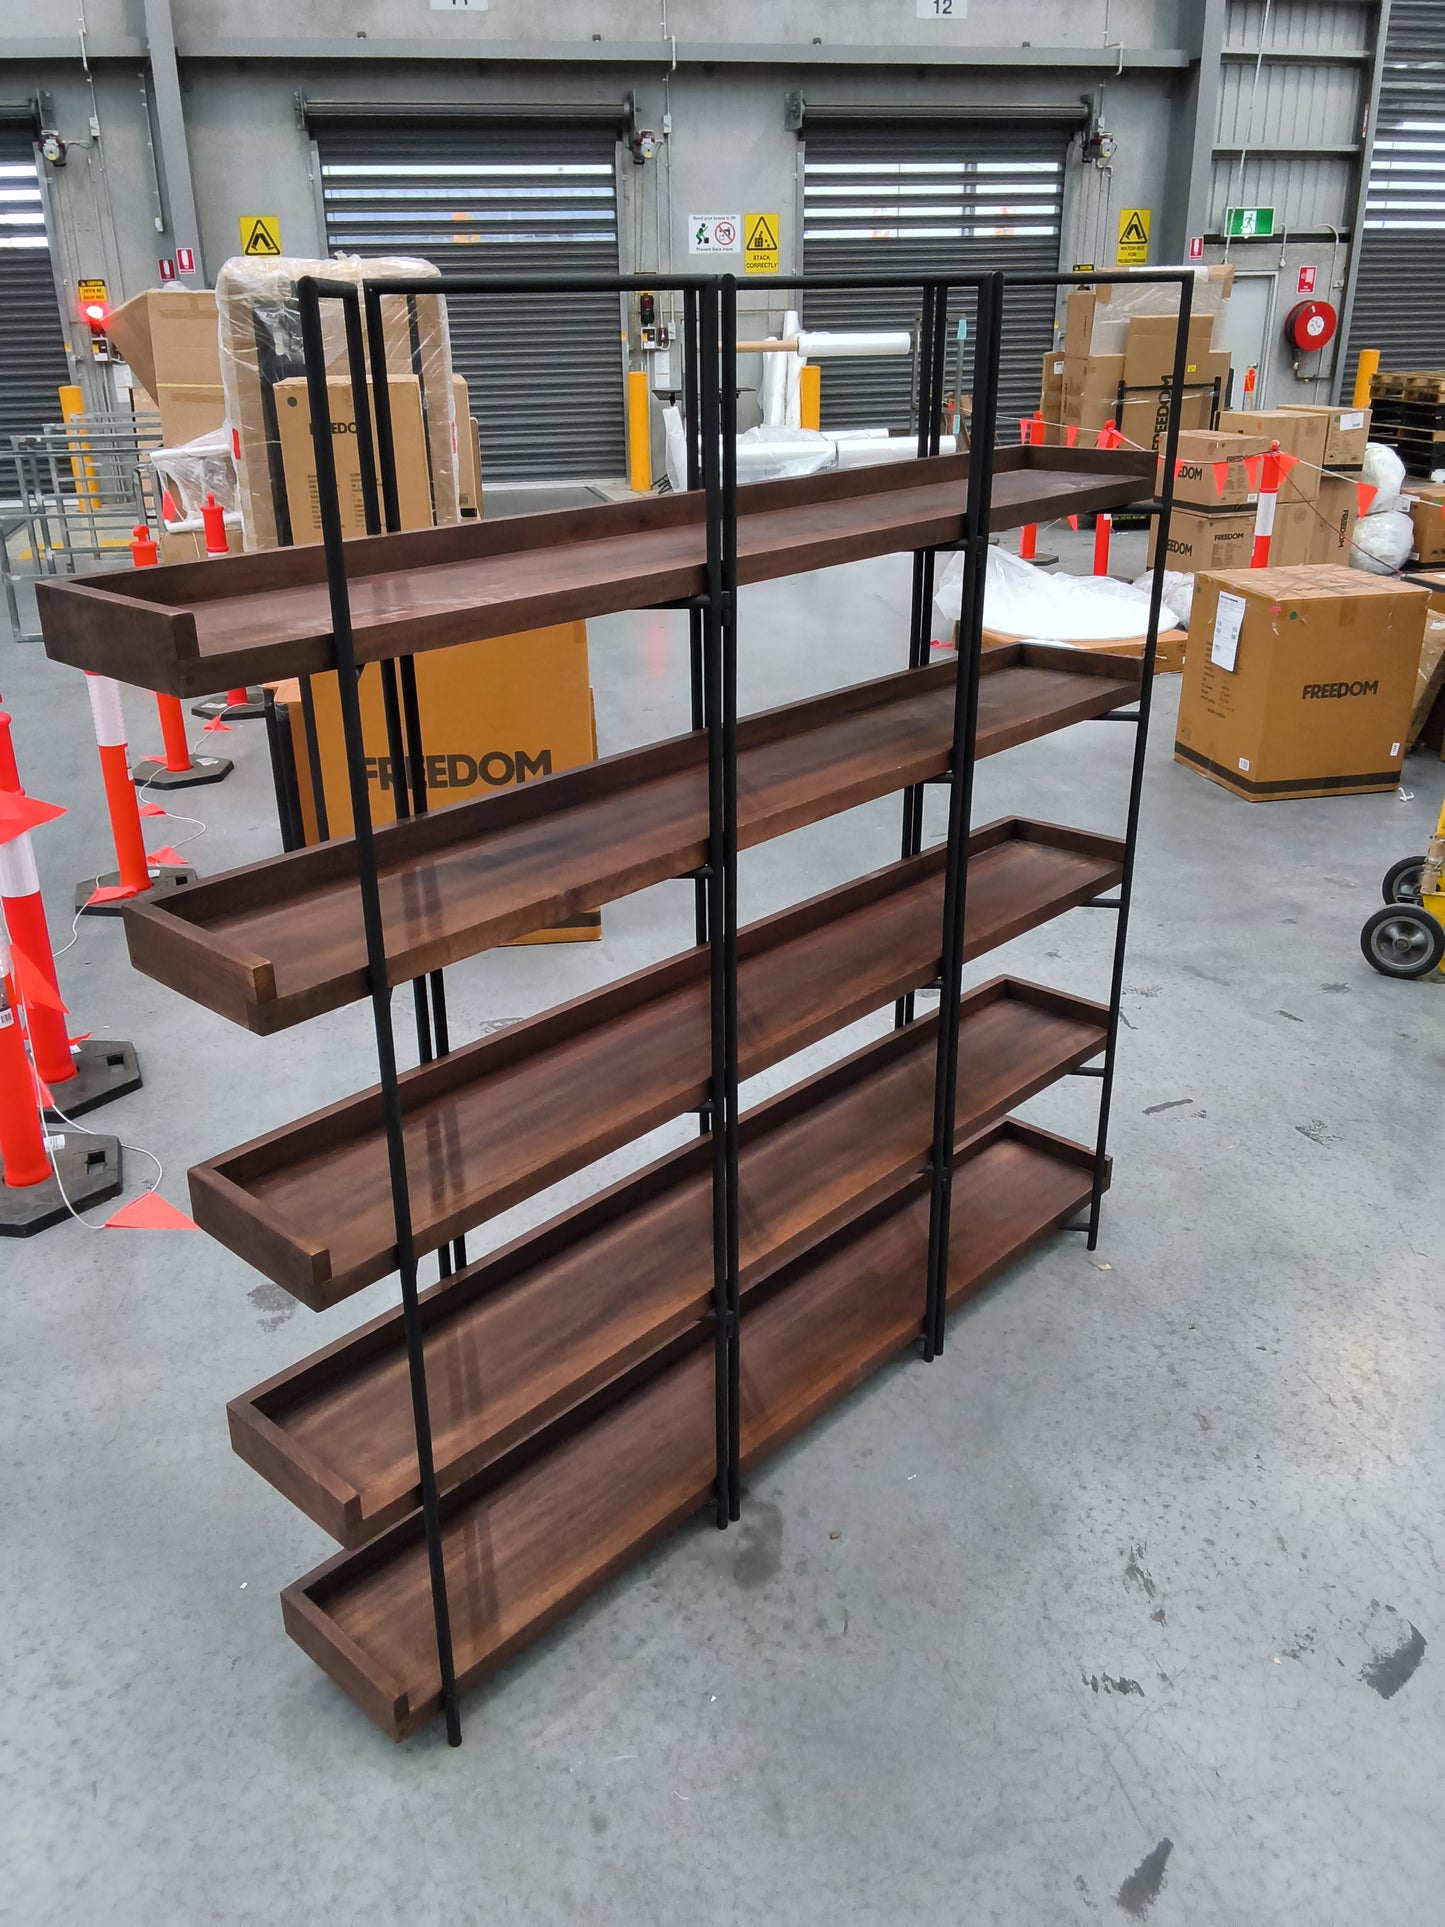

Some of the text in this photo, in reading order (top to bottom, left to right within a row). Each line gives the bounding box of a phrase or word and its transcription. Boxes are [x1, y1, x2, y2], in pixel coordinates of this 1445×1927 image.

[933, 0, 953, 14] 12
[1214, 532, 1244, 541] FREEDOM
[1302, 679, 1379, 700] FREEDOM
